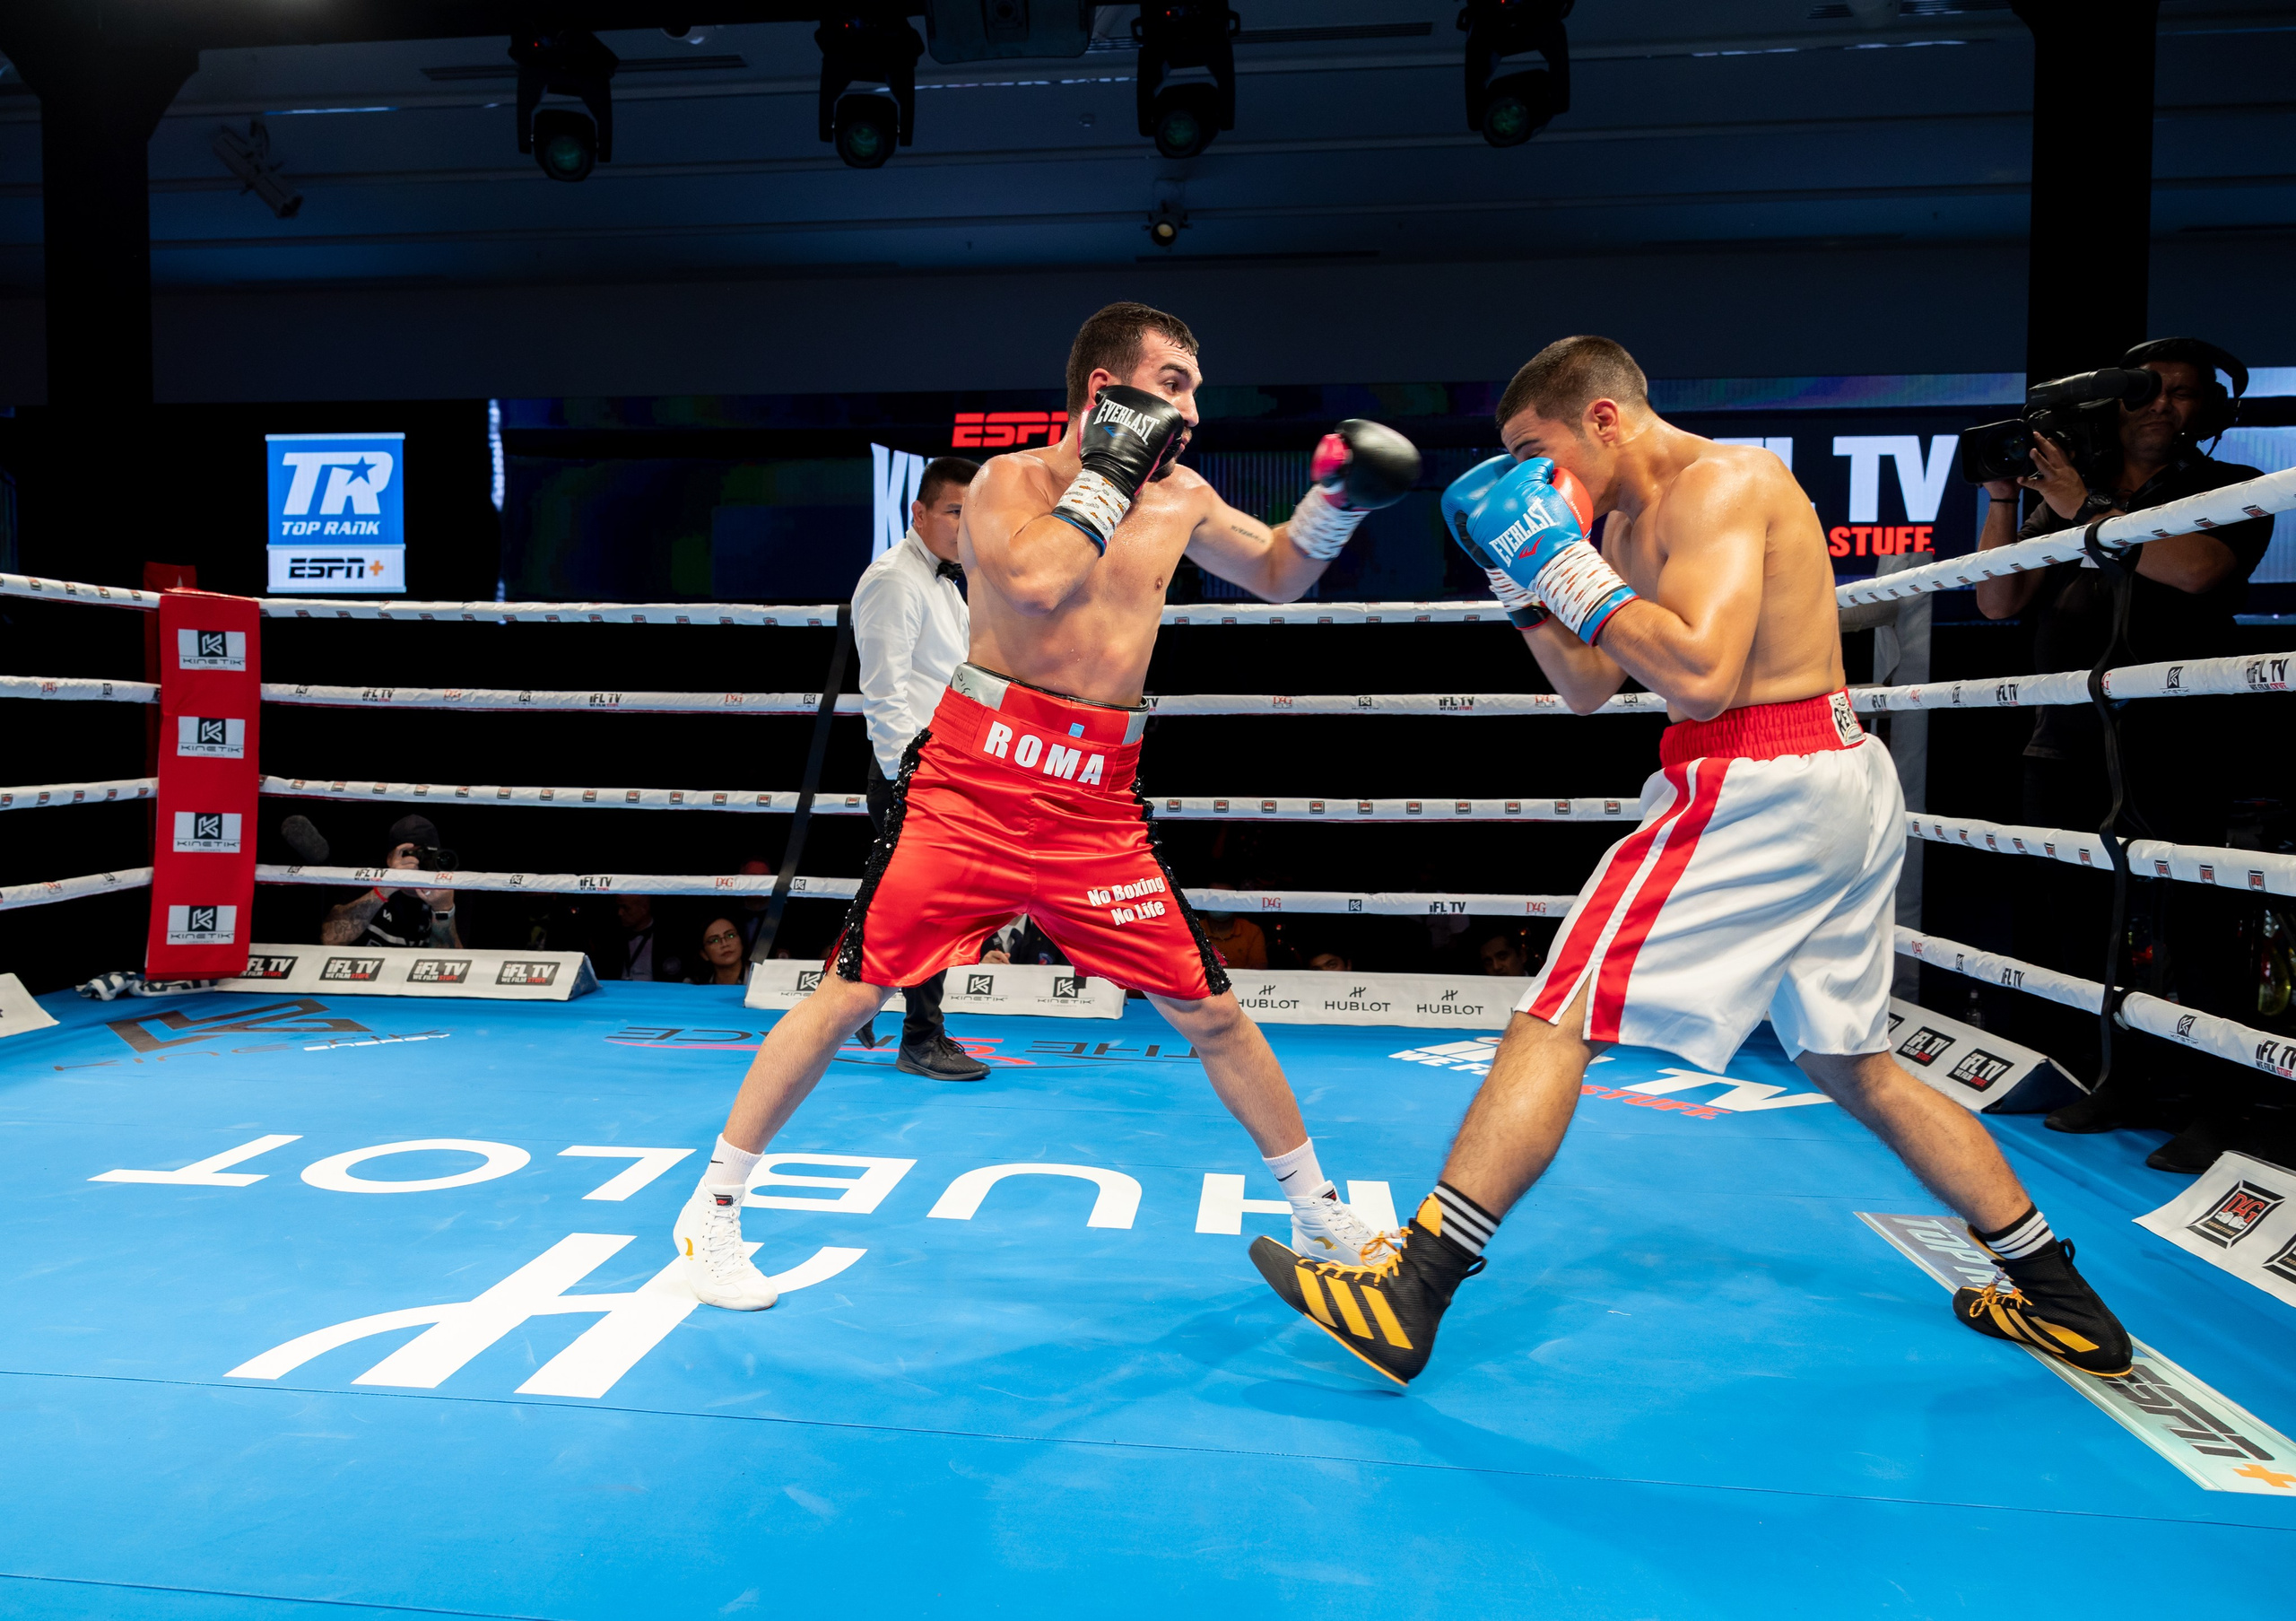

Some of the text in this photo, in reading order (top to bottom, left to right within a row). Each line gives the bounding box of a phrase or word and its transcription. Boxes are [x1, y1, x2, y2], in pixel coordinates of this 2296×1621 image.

[1093, 399, 1161, 446] EVERLAST
[282, 451, 394, 515] TR
[1833, 435, 1959, 522] TV
[282, 521, 379, 536] TOP RANK
[1489, 496, 1560, 568] EVERLAST
[2270, 658, 2290, 682] TV
[983, 720, 1105, 786] ROMA
[1087, 876, 1166, 906] No Boxing
[1110, 901, 1166, 926] No Life
[248, 958, 293, 972] FL TV
[326, 959, 379, 974] iFL TV
[413, 962, 467, 976] iFL TV
[502, 963, 555, 979] iFL TV
[1325, 1000, 1391, 1012] HUBLOT
[1416, 1004, 1484, 1015] HUBLOT
[1924, 1037, 1951, 1056] TV
[2256, 1038, 2280, 1064] iFL
[1978, 1059, 2008, 1081] TV
[2256, 1059, 2265, 1069] WE
[87, 1134, 1403, 1244] HUBLOT
